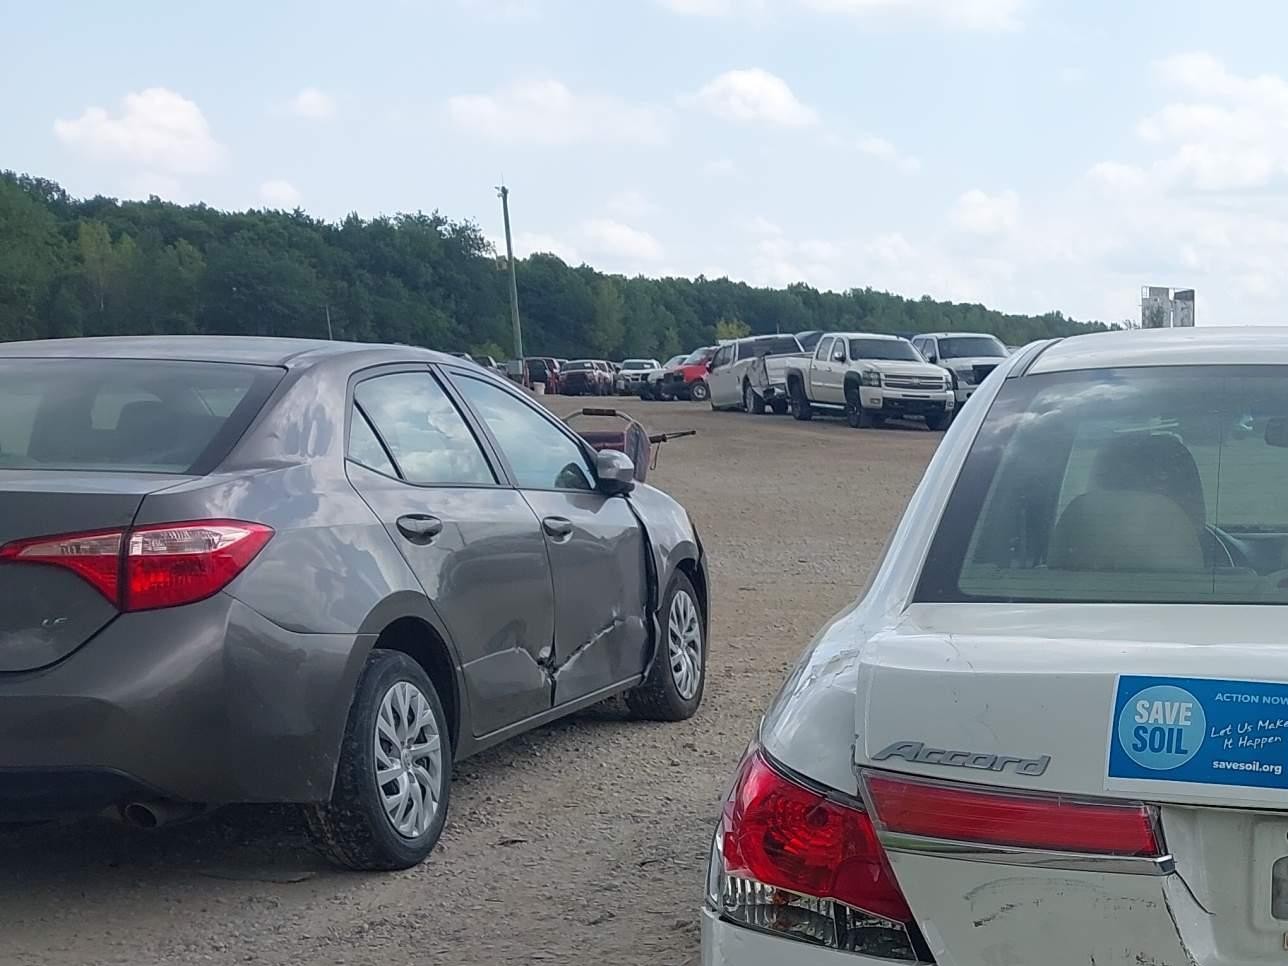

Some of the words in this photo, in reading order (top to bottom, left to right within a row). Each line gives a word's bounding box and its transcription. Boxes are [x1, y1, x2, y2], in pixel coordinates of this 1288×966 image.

[1215, 692, 1259, 704] ACTION
[1134, 699, 1193, 726] SAVE
[1210, 724, 1232, 738] Let
[1237, 722, 1253, 734] Us
[1131, 725, 1189, 755] SOIL
[1223, 737, 1233, 751] It
[1238, 735, 1282, 750] Happen
[871, 740, 1052, 777] Accord
[1212, 761, 1282, 775] savesoil.org
